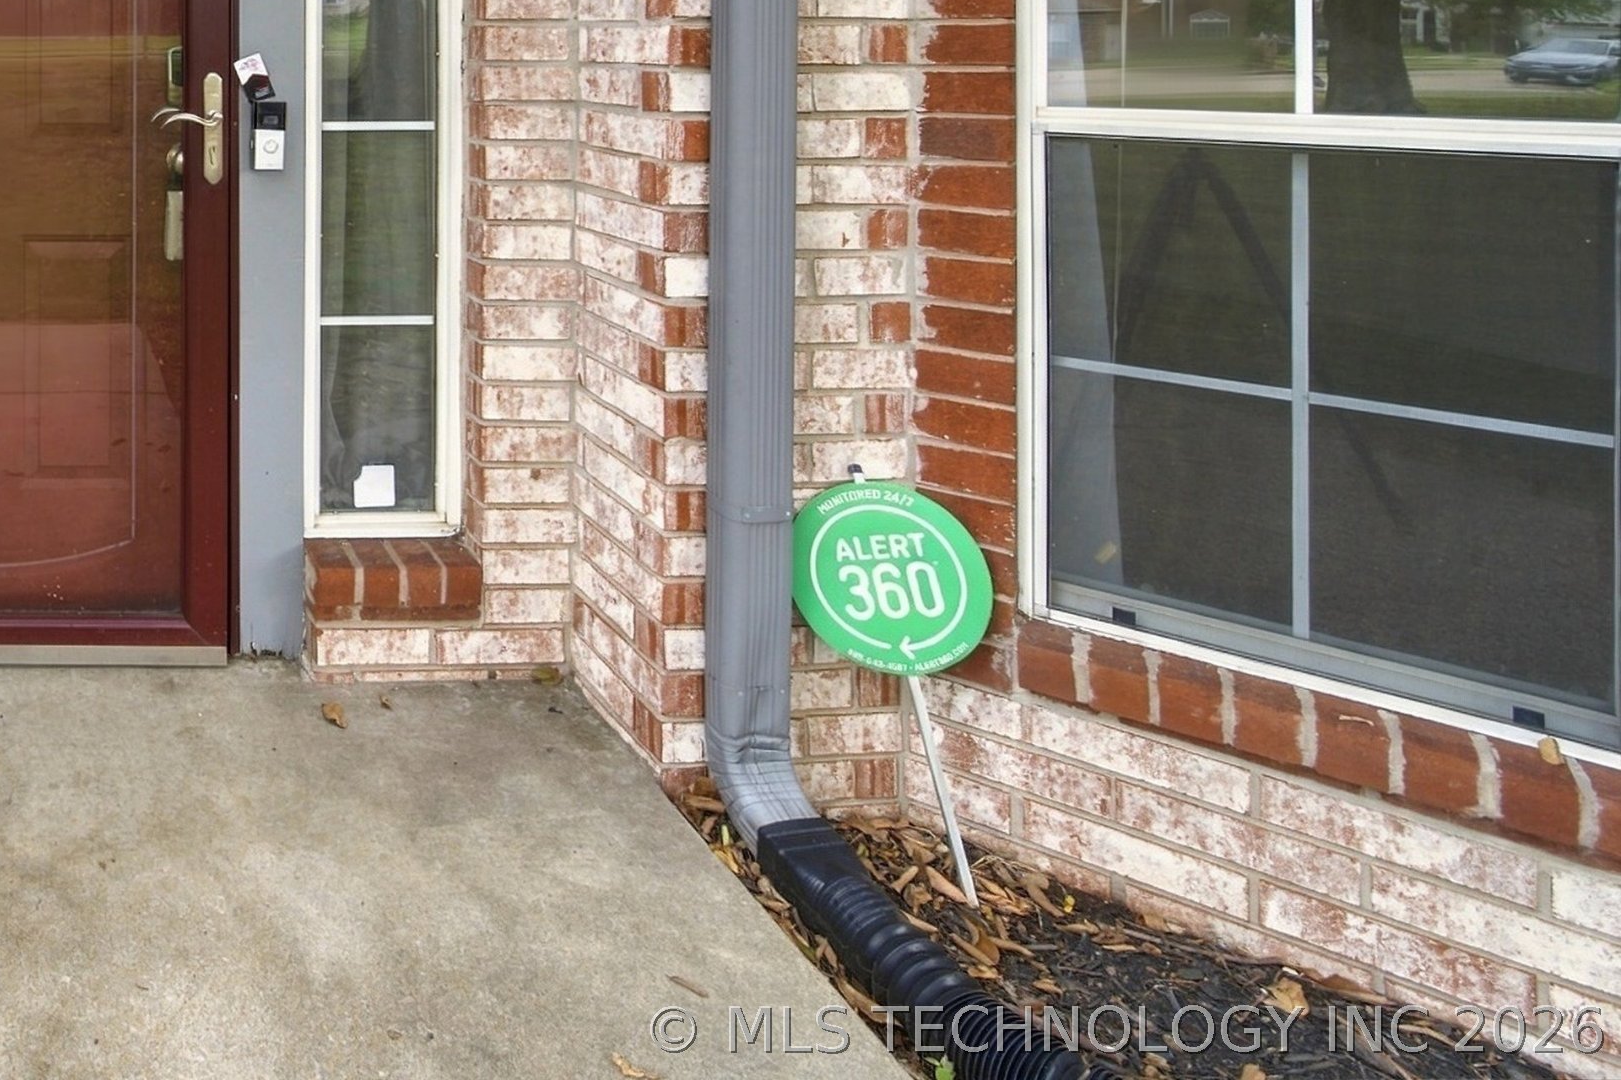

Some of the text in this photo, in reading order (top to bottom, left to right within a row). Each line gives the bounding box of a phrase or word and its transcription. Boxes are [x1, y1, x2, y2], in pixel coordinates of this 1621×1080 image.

[817, 489, 915, 515] MONITORED 24/7
[836, 532, 925, 562] ALERT
[838, 561, 945, 622] 360
